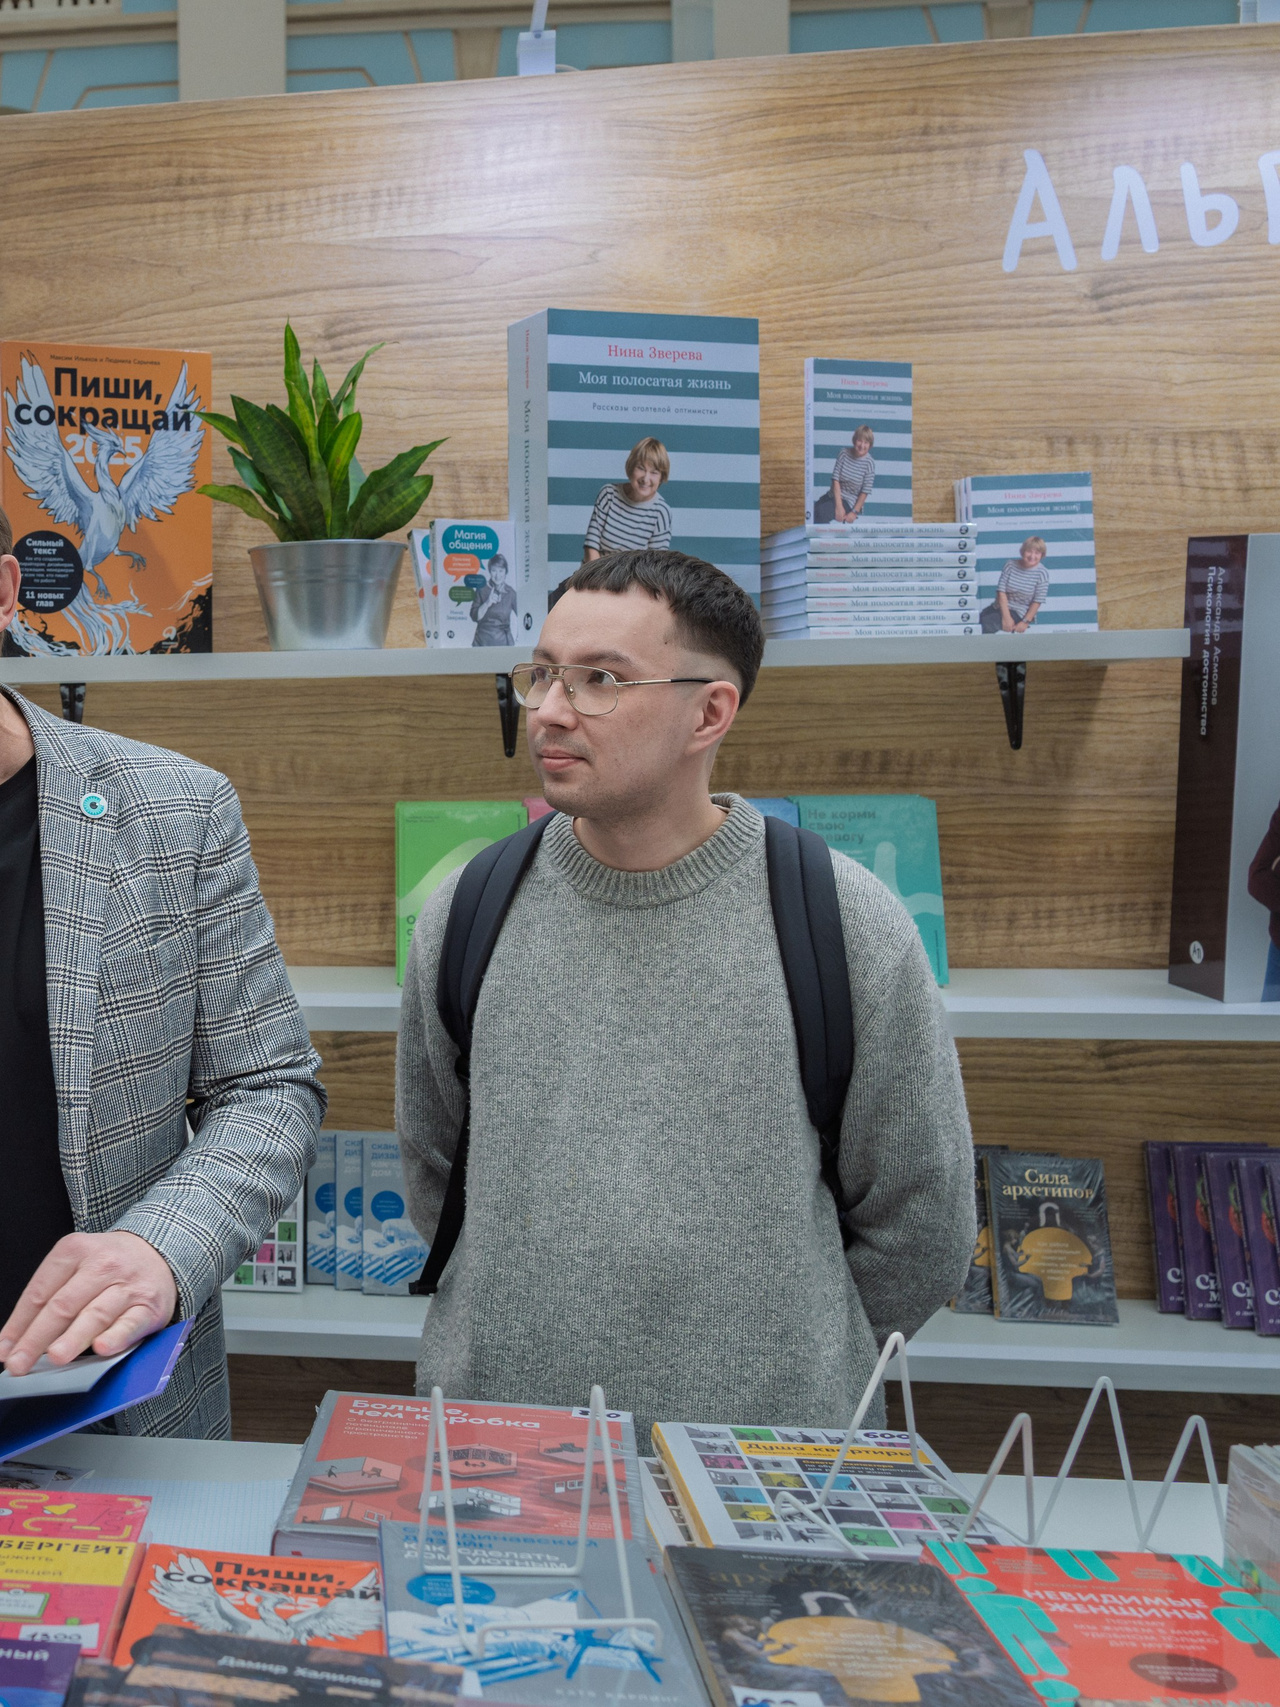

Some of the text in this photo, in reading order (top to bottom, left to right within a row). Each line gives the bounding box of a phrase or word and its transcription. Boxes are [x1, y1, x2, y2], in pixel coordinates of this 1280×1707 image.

[608, 345, 703, 362] Нина Зверева
[54, 367, 162, 405] Пиши,
[578, 371, 731, 390] Моя полосатая жизнь
[592, 403, 629, 412] Рассказы
[14, 403, 190, 435] сокращай
[65, 433, 143, 466] 205
[26, 538, 64, 547] Сильный
[454, 530, 486, 540] Магия
[449, 541, 493, 551] общения
[26, 591, 35, 599] 11
[1211, 566, 1226, 705] Александр Асмолов
[1200, 566, 1216, 735] Психология достоинства
[807, 809, 876, 822] Не корми
[808, 822, 845, 831] свою
[1024, 1168, 1070, 1186] Сила
[1002, 1183, 1094, 1203] архетипов
[349, 1408, 403, 1419] чем
[353, 1399, 469, 1417] Болье,
[746, 1443, 805, 1452] Душа
[215, 1561, 345, 1586] Пиши,
[162, 1571, 382, 1602] сокращай
[221, 1588, 319, 1611] 205
[1023, 1589, 1209, 1609] НЕВИДИМЫЕ
[1045, 1601, 1209, 1620] ЖЕНЩИНЫ
[217, 1655, 288, 1675] Дамир
